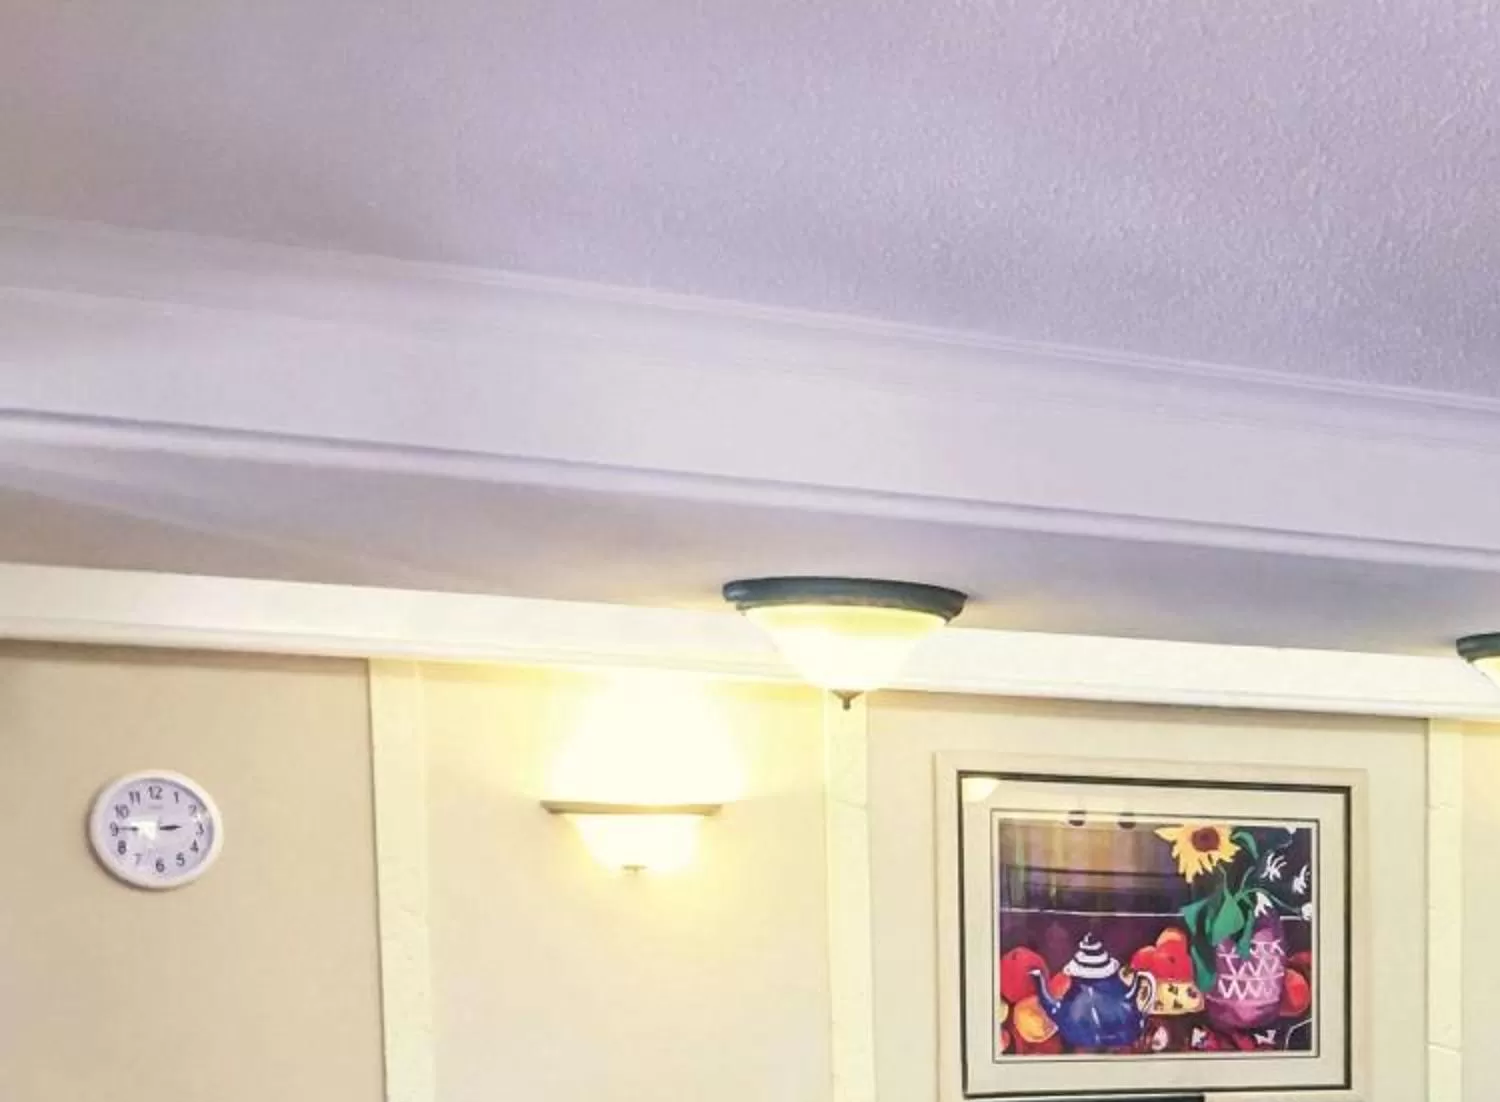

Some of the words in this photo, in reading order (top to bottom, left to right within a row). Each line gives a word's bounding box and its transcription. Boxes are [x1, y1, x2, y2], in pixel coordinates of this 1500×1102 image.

[128, 791, 141, 805] 11
[148, 785, 163, 800] 12
[174, 791, 180, 804] 1
[114, 803, 130, 820] 10
[188, 804, 198, 817] 2
[109, 821, 119, 837] 9
[195, 821, 205, 837] 3
[117, 839, 127, 855] 8
[189, 838, 199, 853] 4
[133, 852, 143, 865] 7
[155, 858, 165, 873] 6
[175, 851, 186, 867] 5
